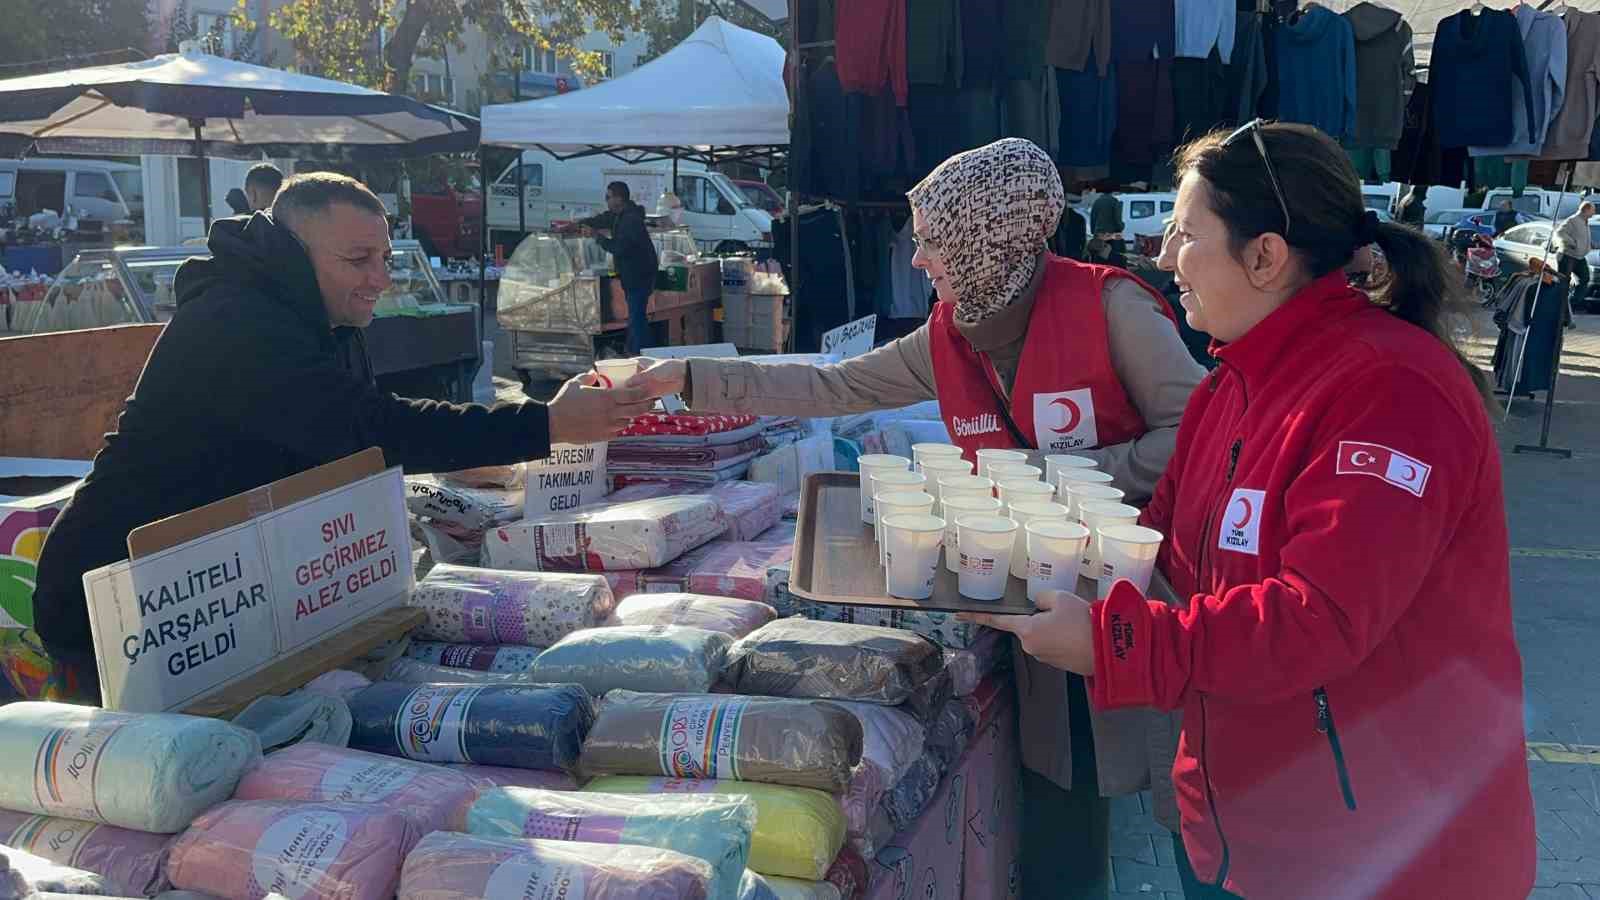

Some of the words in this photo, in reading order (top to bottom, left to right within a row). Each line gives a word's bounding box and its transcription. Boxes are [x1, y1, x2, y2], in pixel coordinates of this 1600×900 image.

[952, 412, 1001, 437] Gönüllü
[1049, 438, 1085, 450] KIZILAY
[538, 470, 594, 489] TAKIMLARI
[550, 489, 581, 511] GELDİ
[321, 512, 355, 544] SIVI
[295, 528, 388, 586] GEÇİRMEZ
[138, 551, 243, 617] KALİTELİ
[294, 580, 344, 621] ALEZ
[346, 551, 399, 595] GELDİ
[122, 582, 266, 665] ÇARŞAFLAR
[167, 623, 237, 677] GELDİ
